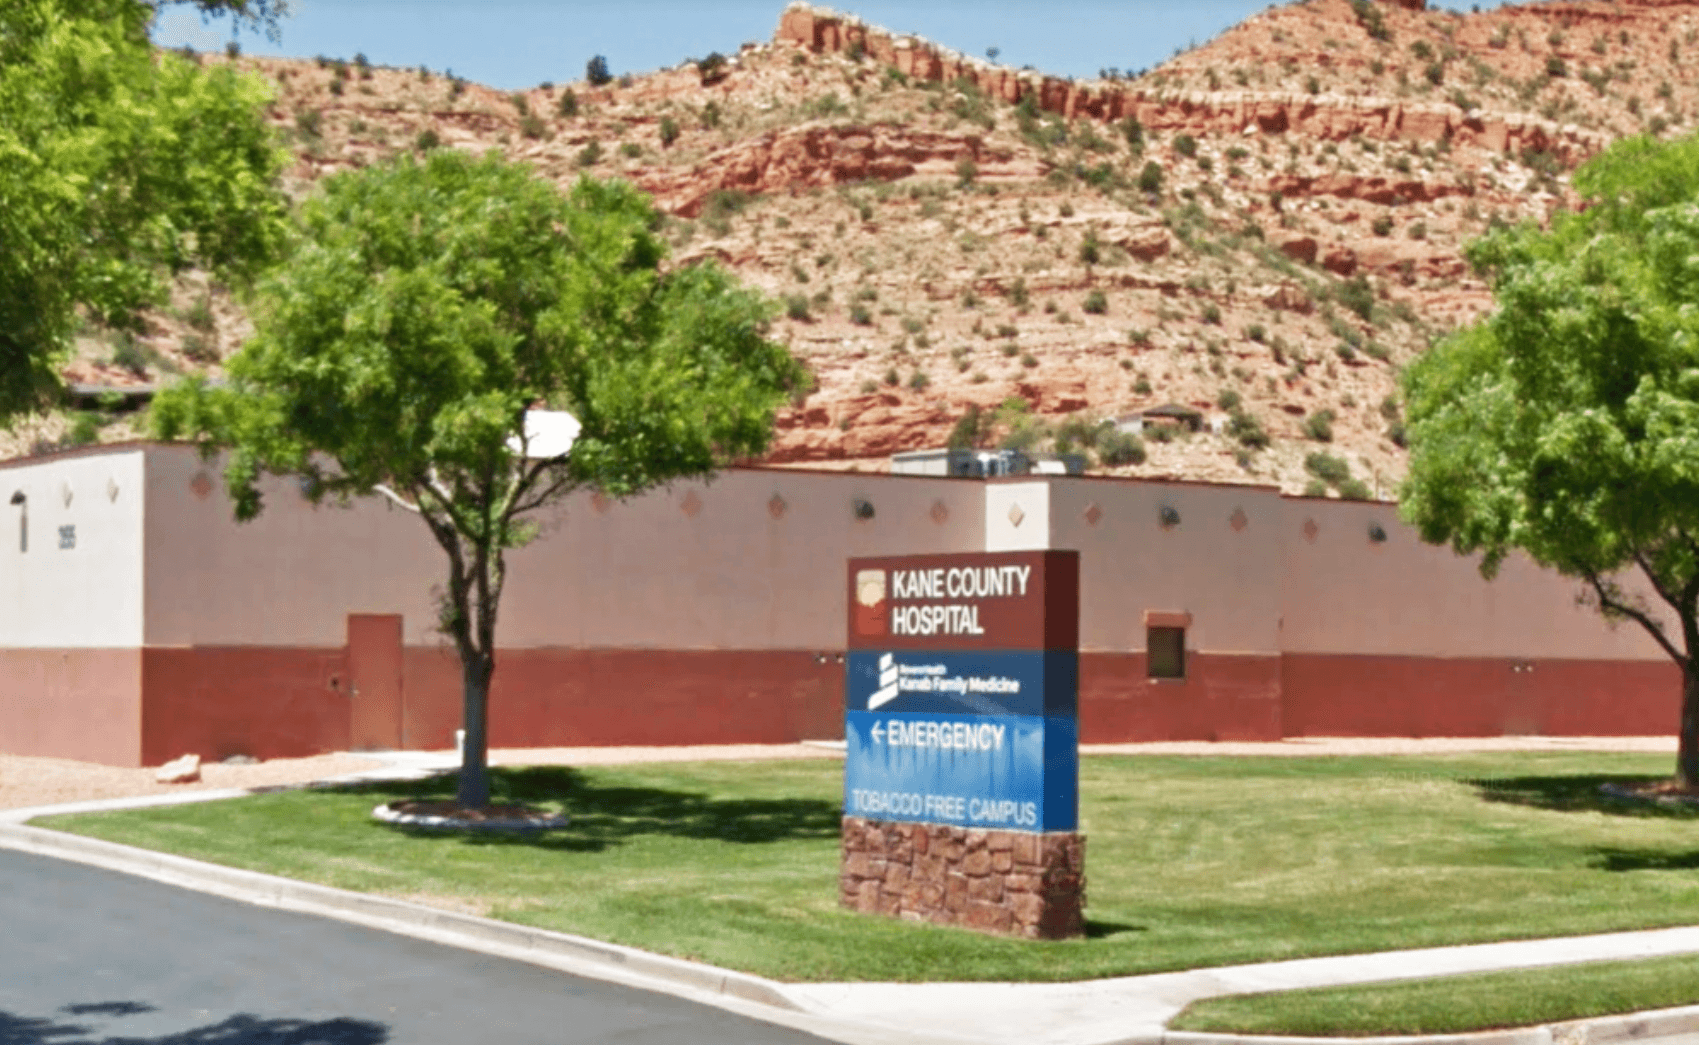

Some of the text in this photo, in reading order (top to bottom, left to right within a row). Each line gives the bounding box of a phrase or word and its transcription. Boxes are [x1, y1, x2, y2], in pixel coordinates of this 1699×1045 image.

[892, 565, 1031, 598] KANE COUNTY
[892, 604, 985, 635] HOSPITAL
[933, 675, 968, 696] Family
[969, 676, 1021, 694] Medicine
[888, 719, 1006, 751] EMERGENCY
[852, 788, 1037, 826] TOBACCO FREE CAMPUS
